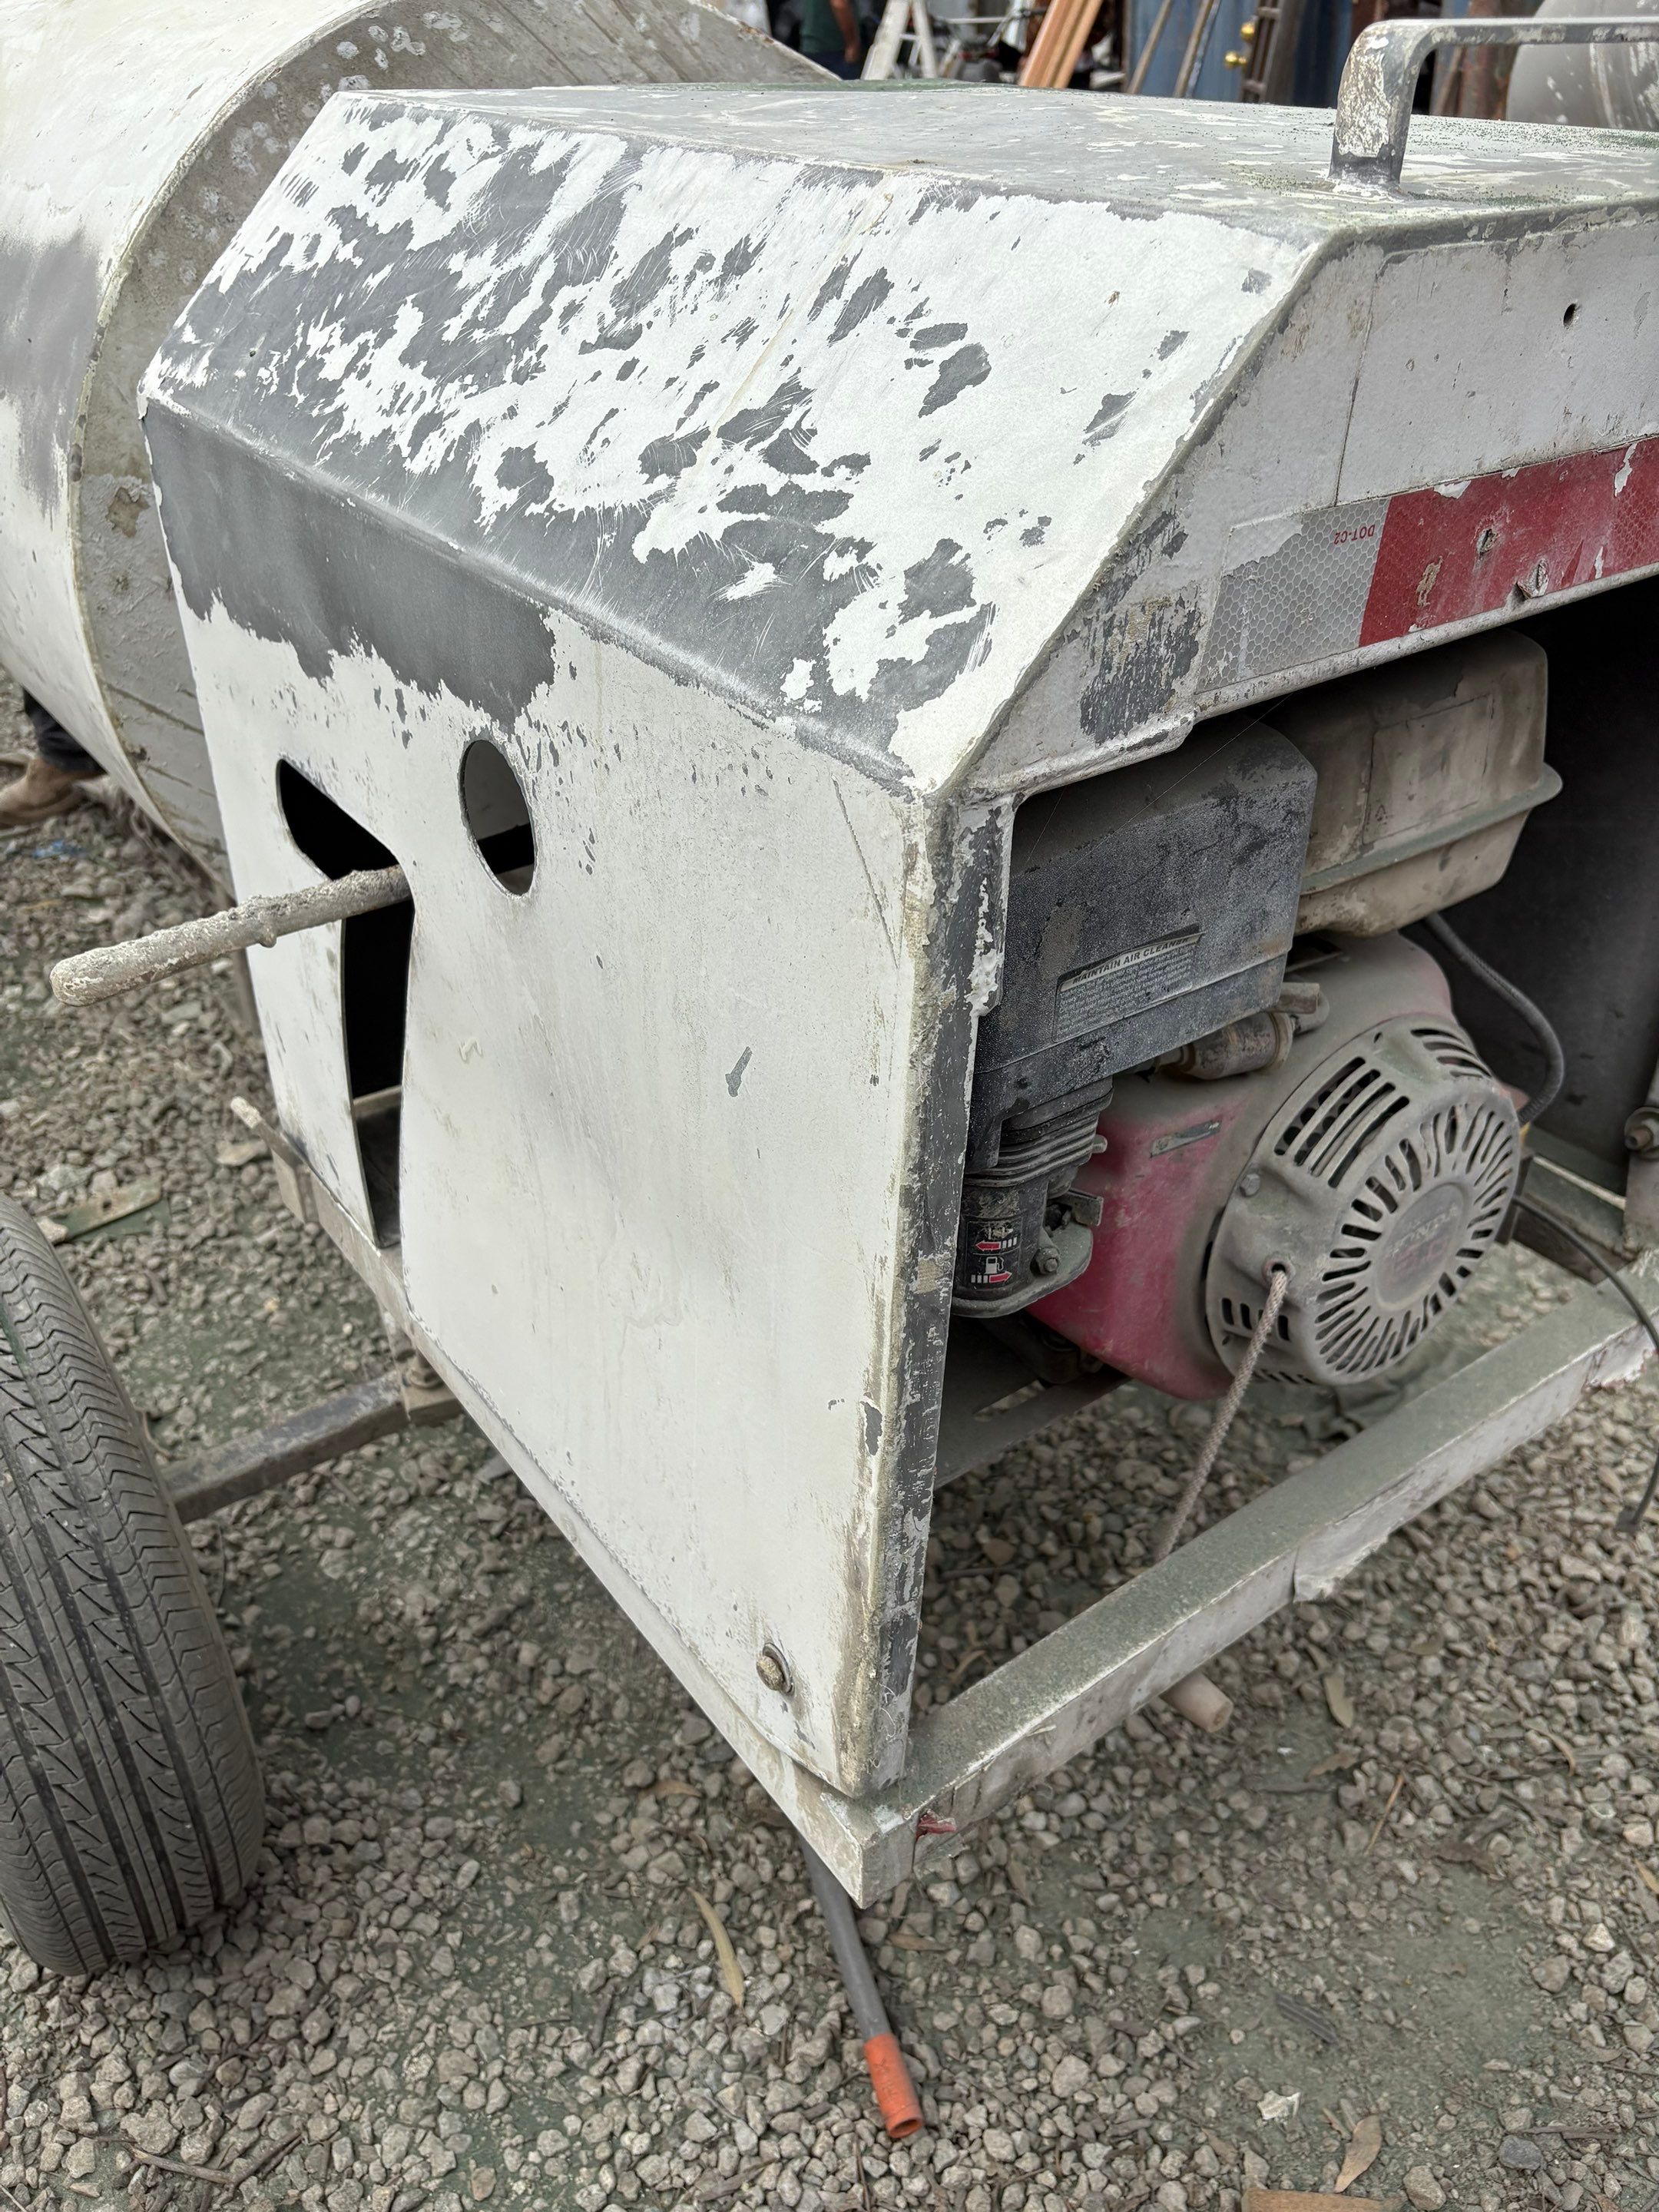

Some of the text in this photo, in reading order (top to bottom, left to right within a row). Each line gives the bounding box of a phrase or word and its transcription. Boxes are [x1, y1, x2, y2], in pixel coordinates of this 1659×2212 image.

[1333, 524, 1376, 545] DOT-C2
[1072, 959, 1121, 984] MAINTAIN
[1123, 952, 1141, 965] AIR
